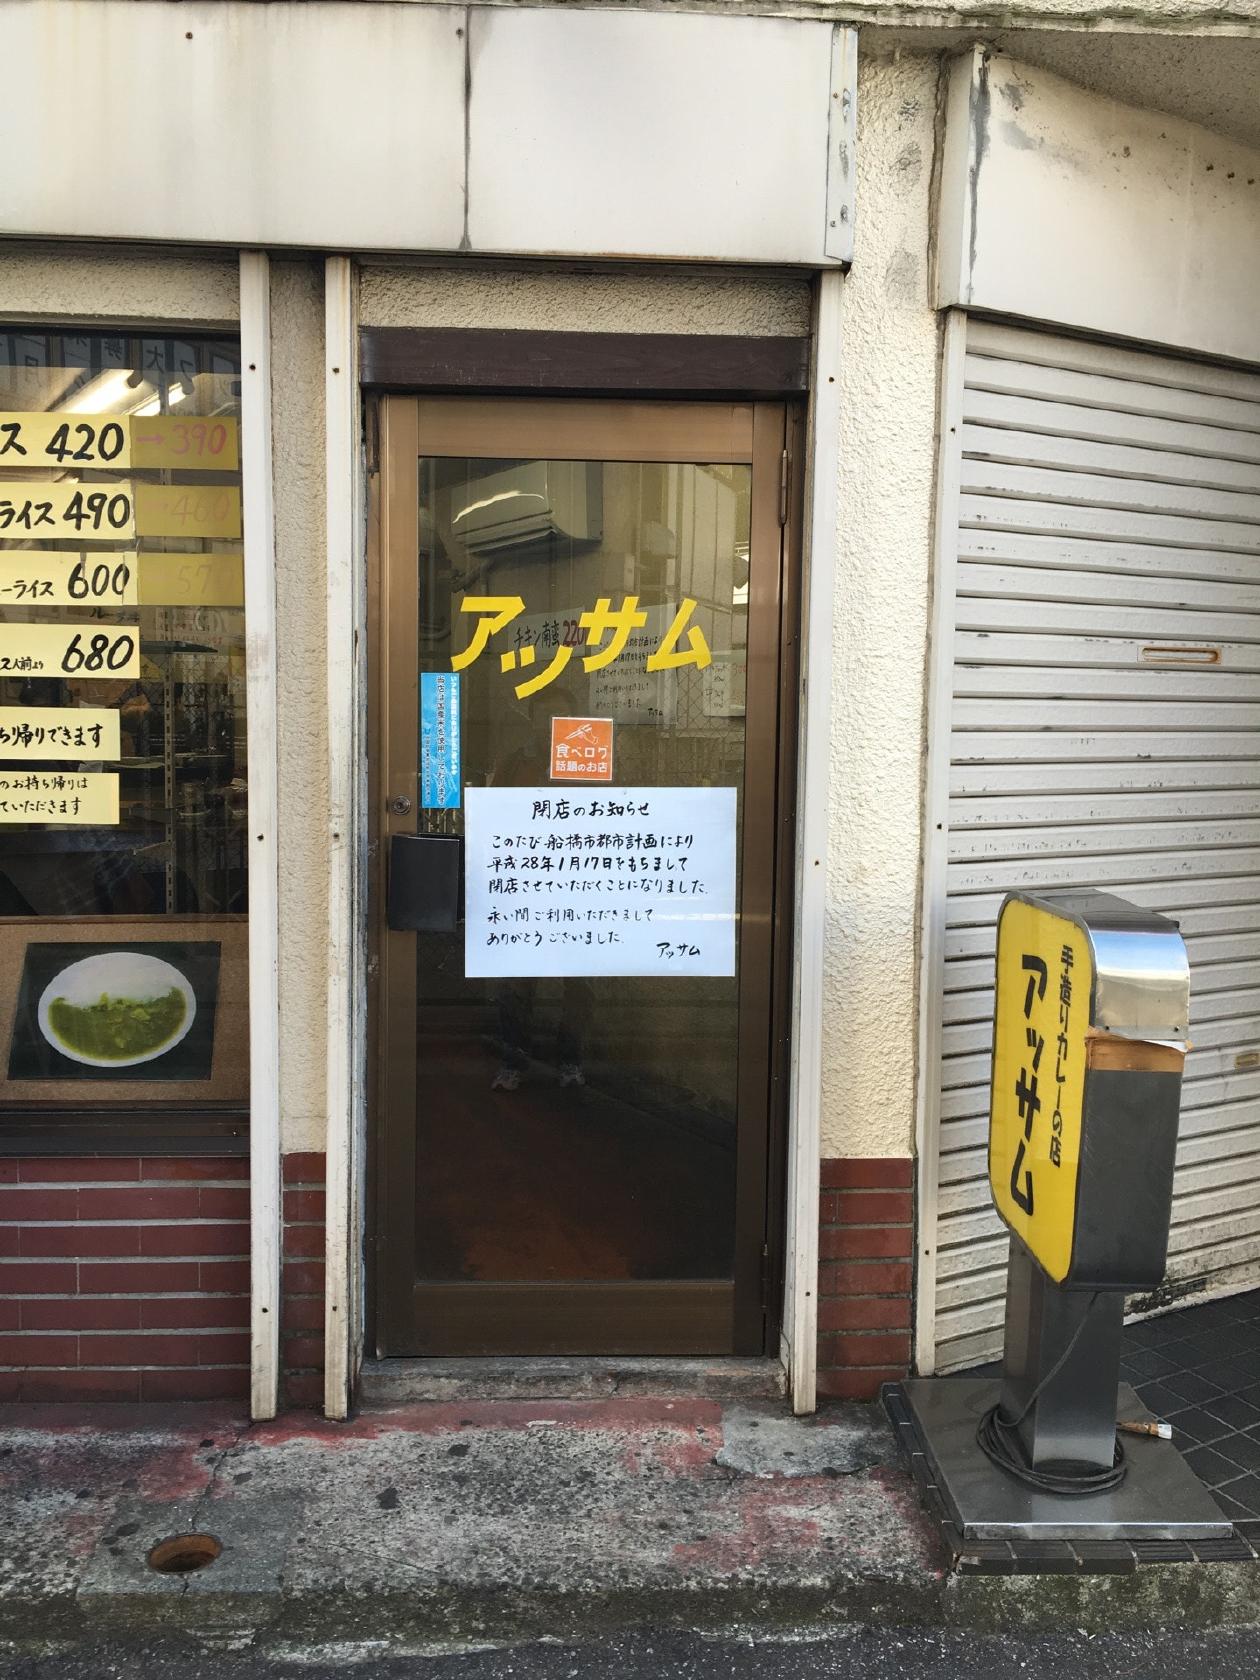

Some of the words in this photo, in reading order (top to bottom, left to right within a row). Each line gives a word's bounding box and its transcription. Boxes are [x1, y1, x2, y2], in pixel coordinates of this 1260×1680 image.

[45, 423, 124, 462] 420
[171, 424, 228, 455] 390
[0, 500, 56, 530] ライス
[62, 491, 131, 531] 490
[1, 579, 54, 599] ーライス
[67, 562, 130, 599] 600
[61, 633, 134, 673] 680
[451, 596, 712, 700] アッサム
[0, 723, 103, 748] ち帰りできます
[555, 743, 609, 759] 食べログ
[555, 760, 608, 773] 話題のお店
[0, 775, 88, 791] のお持ち帰りは
[0, 796, 82, 815] ていただきます
[531, 800, 650, 820] 閉店のお知らせ
[487, 856, 688, 872] 平成28年1月17日をもちまして
[656, 942, 701, 959] アッサム
[1048, 944, 1075, 1168] 手造りカレーの店
[1011, 954, 1048, 1216] アッサム
